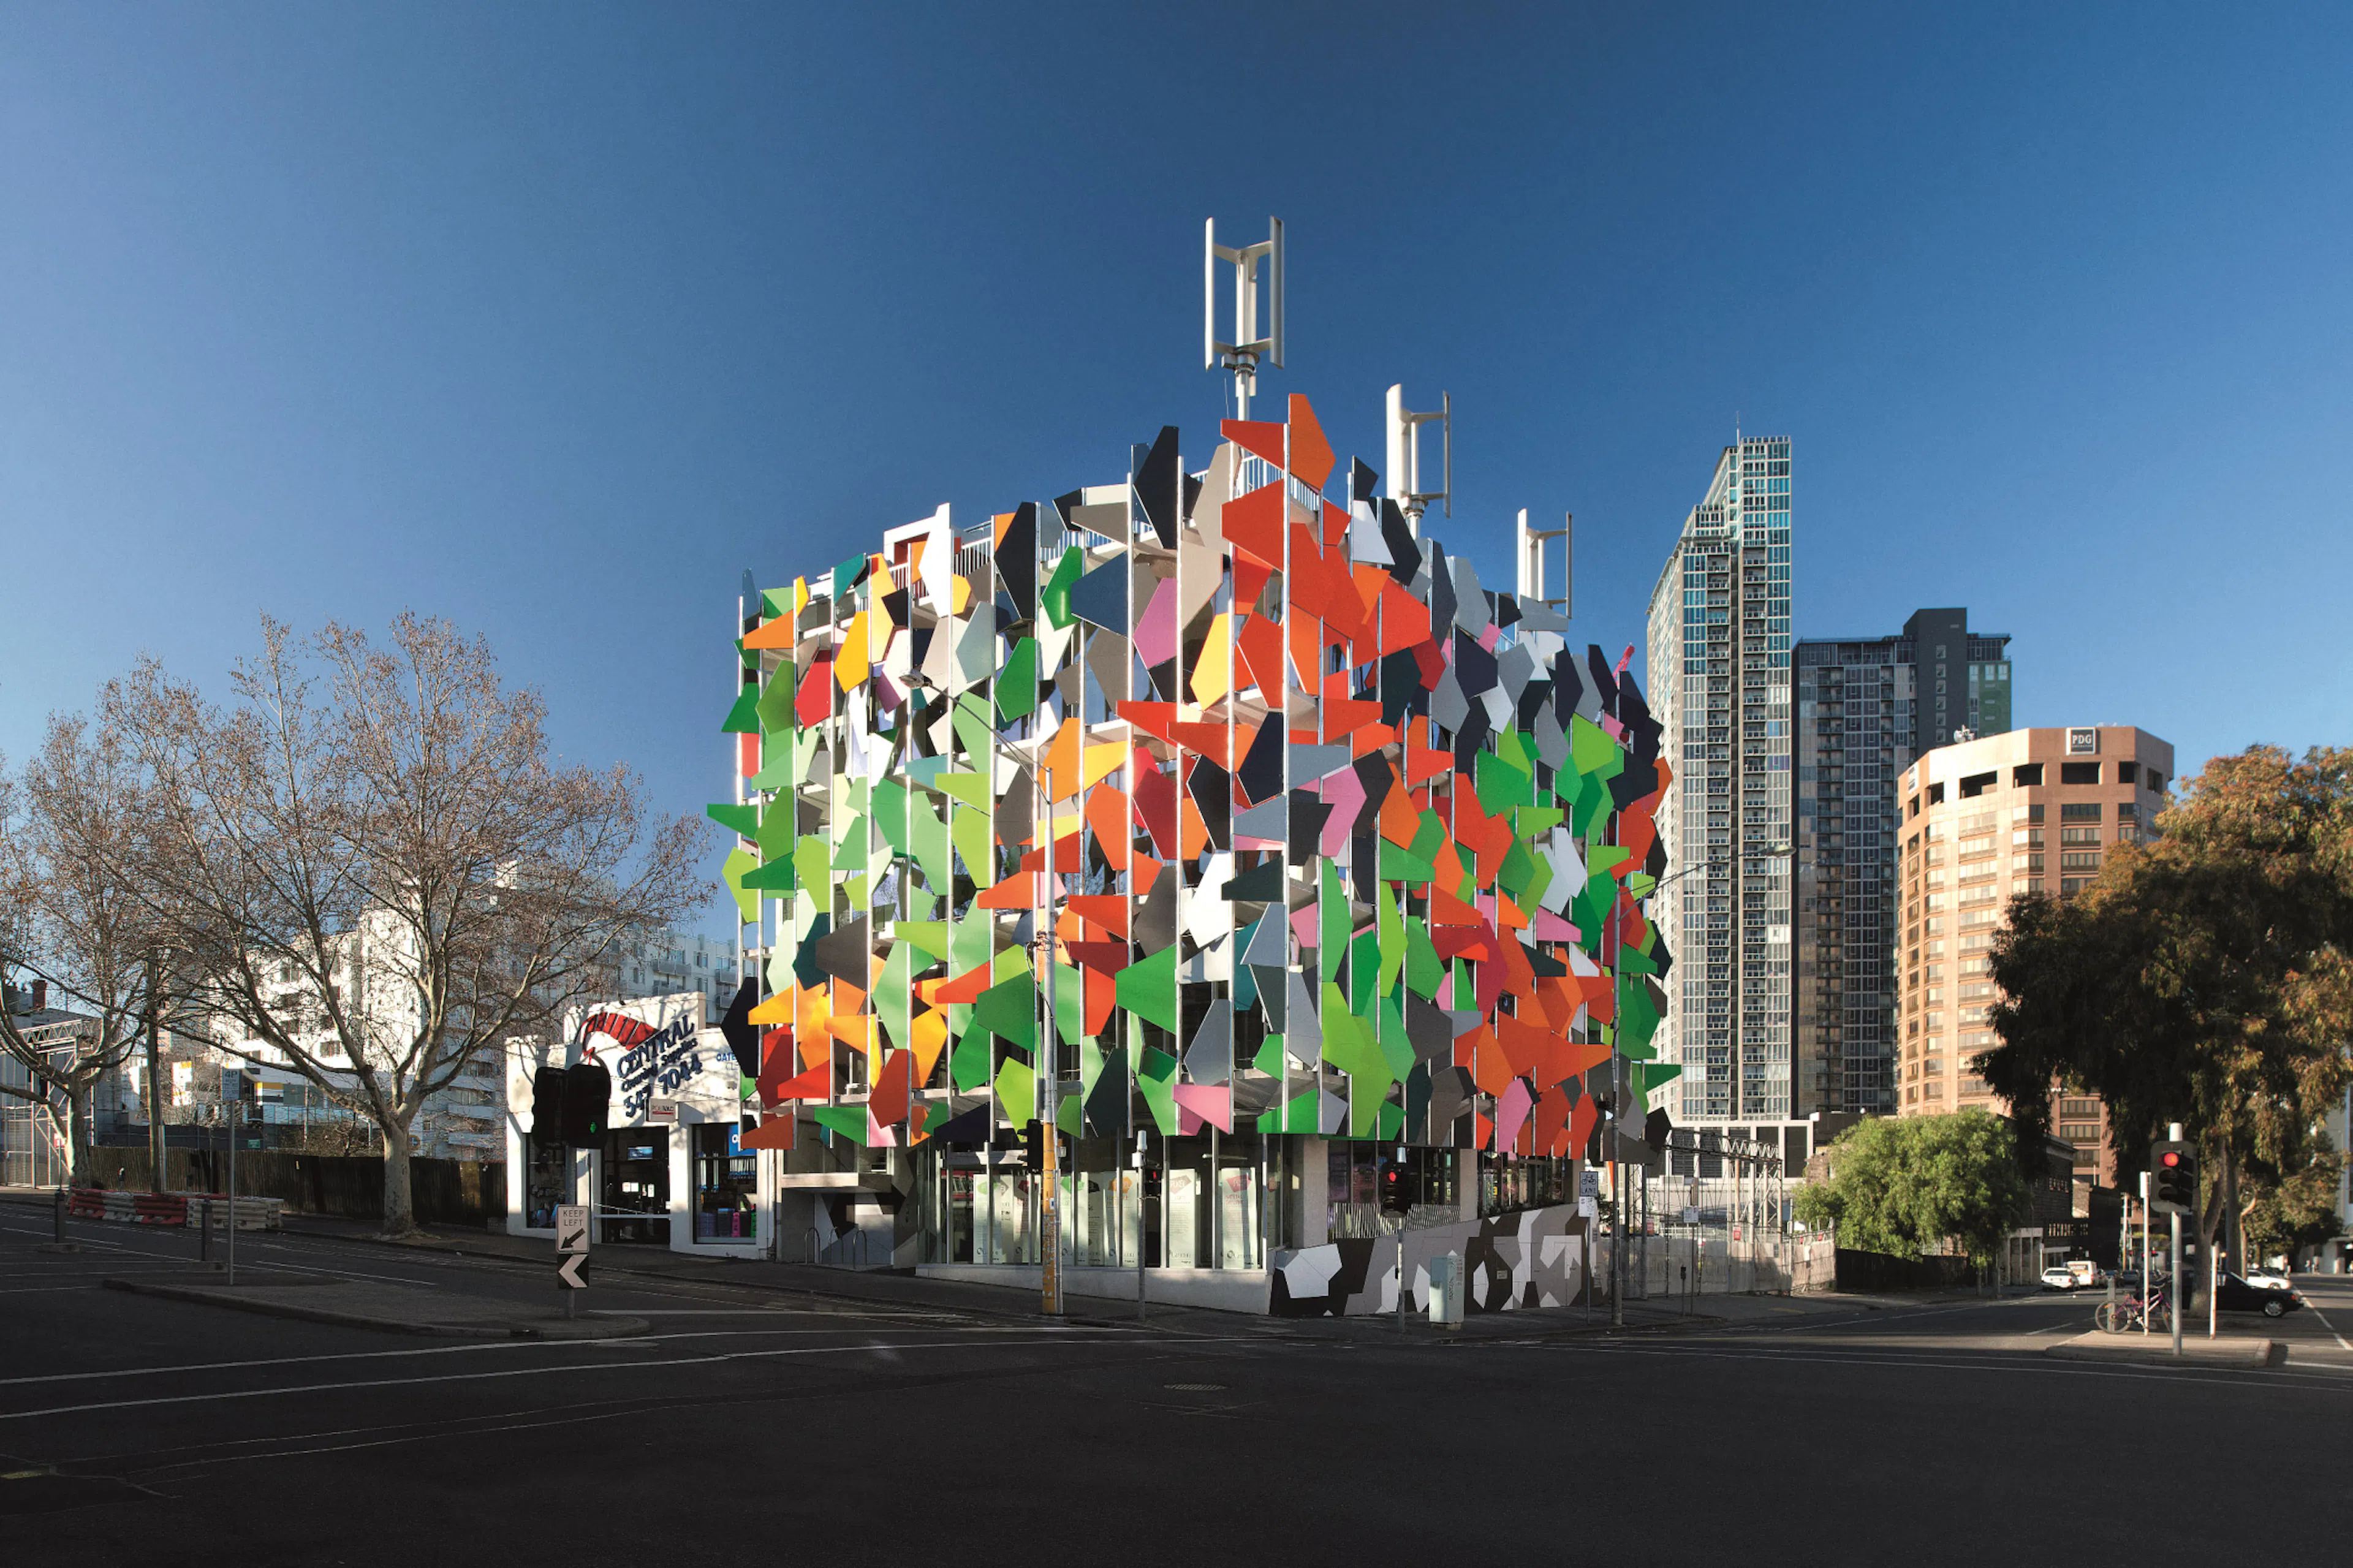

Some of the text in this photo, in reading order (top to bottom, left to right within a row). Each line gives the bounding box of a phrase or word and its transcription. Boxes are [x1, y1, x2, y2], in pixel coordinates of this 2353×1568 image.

[2072, 734, 2092, 744] PDG
[616, 1015, 694, 1078] CENTRAL
[623, 1053, 703, 1118] 547 7044
